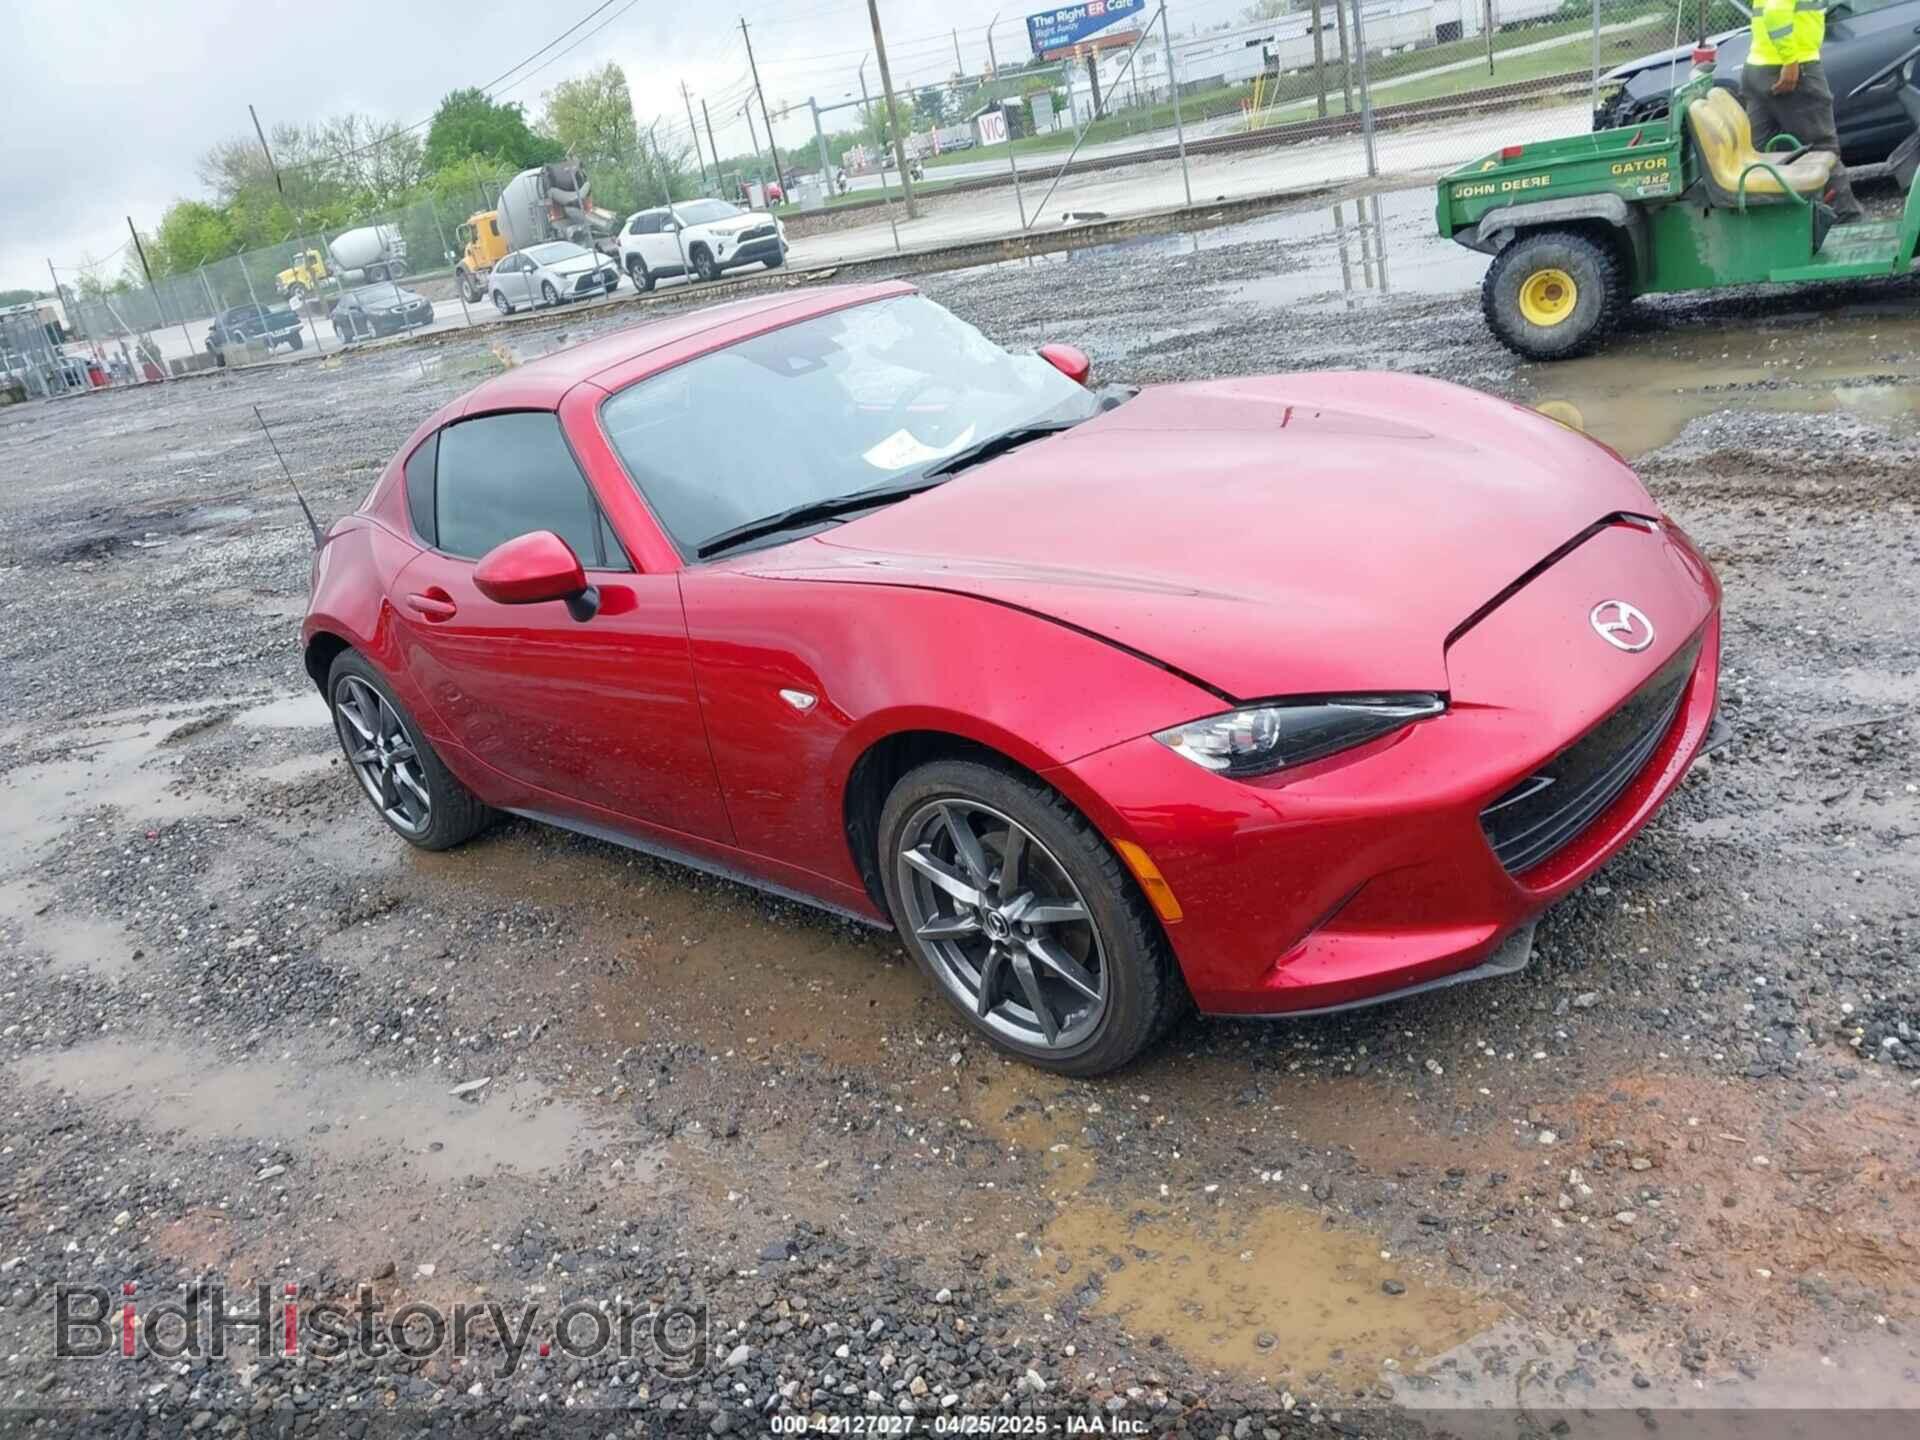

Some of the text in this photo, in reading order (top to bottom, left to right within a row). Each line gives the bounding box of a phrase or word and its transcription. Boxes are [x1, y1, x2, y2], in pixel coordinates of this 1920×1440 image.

[1033, 0, 1134, 27] The Right ER Care
[982, 116, 1005, 140] VIC
[1612, 158, 1667, 175] GATOR
[1456, 175, 1551, 198] JOHN DEERE
